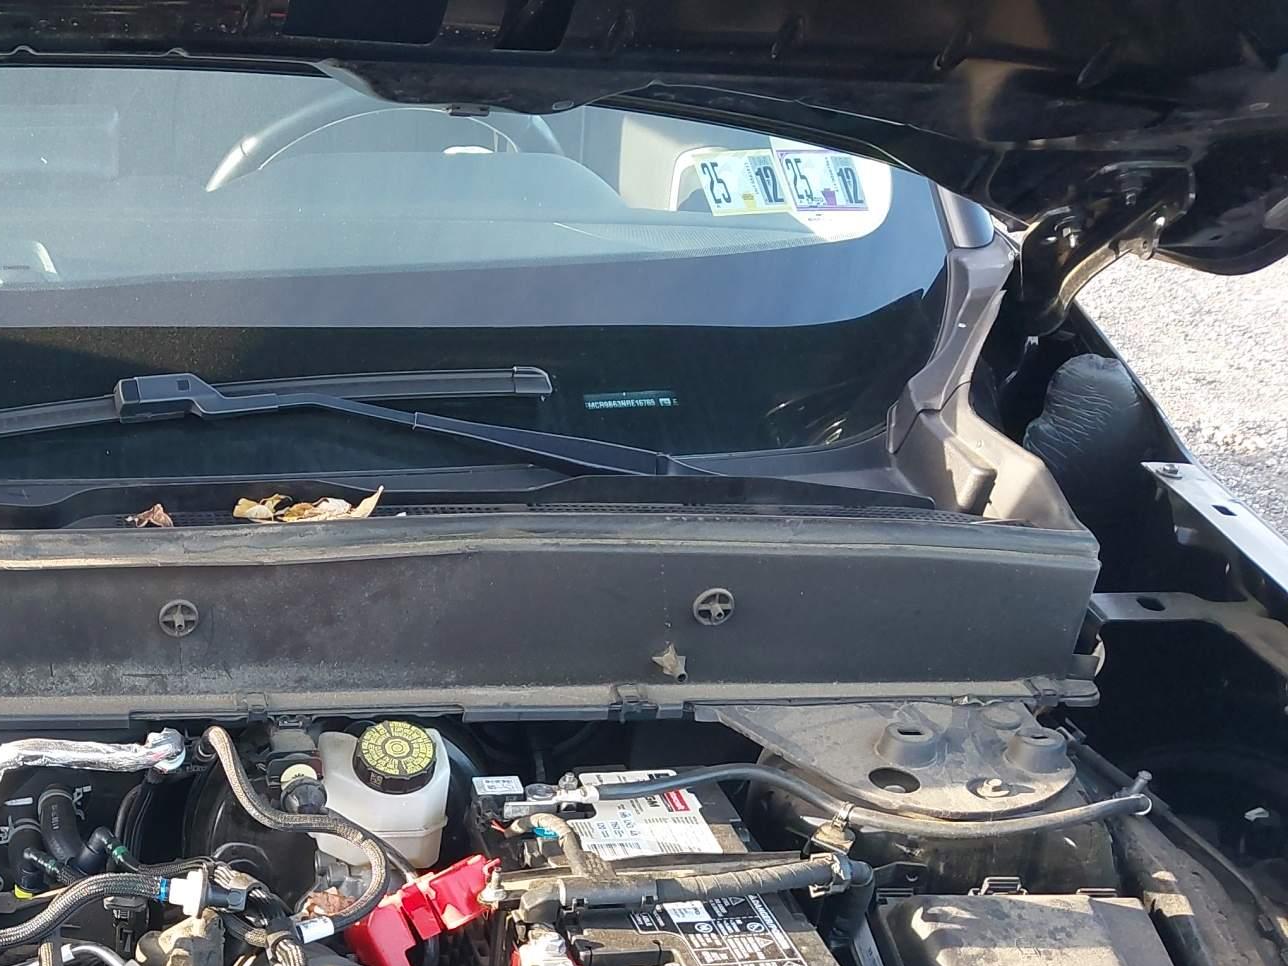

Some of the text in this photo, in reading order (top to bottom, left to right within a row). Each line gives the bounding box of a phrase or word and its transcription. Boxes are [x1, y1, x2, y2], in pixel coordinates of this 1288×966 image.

[701, 162, 732, 204] 25
[755, 166, 785, 203] 12
[785, 158, 814, 200] 25
[837, 167, 863, 204] 12
